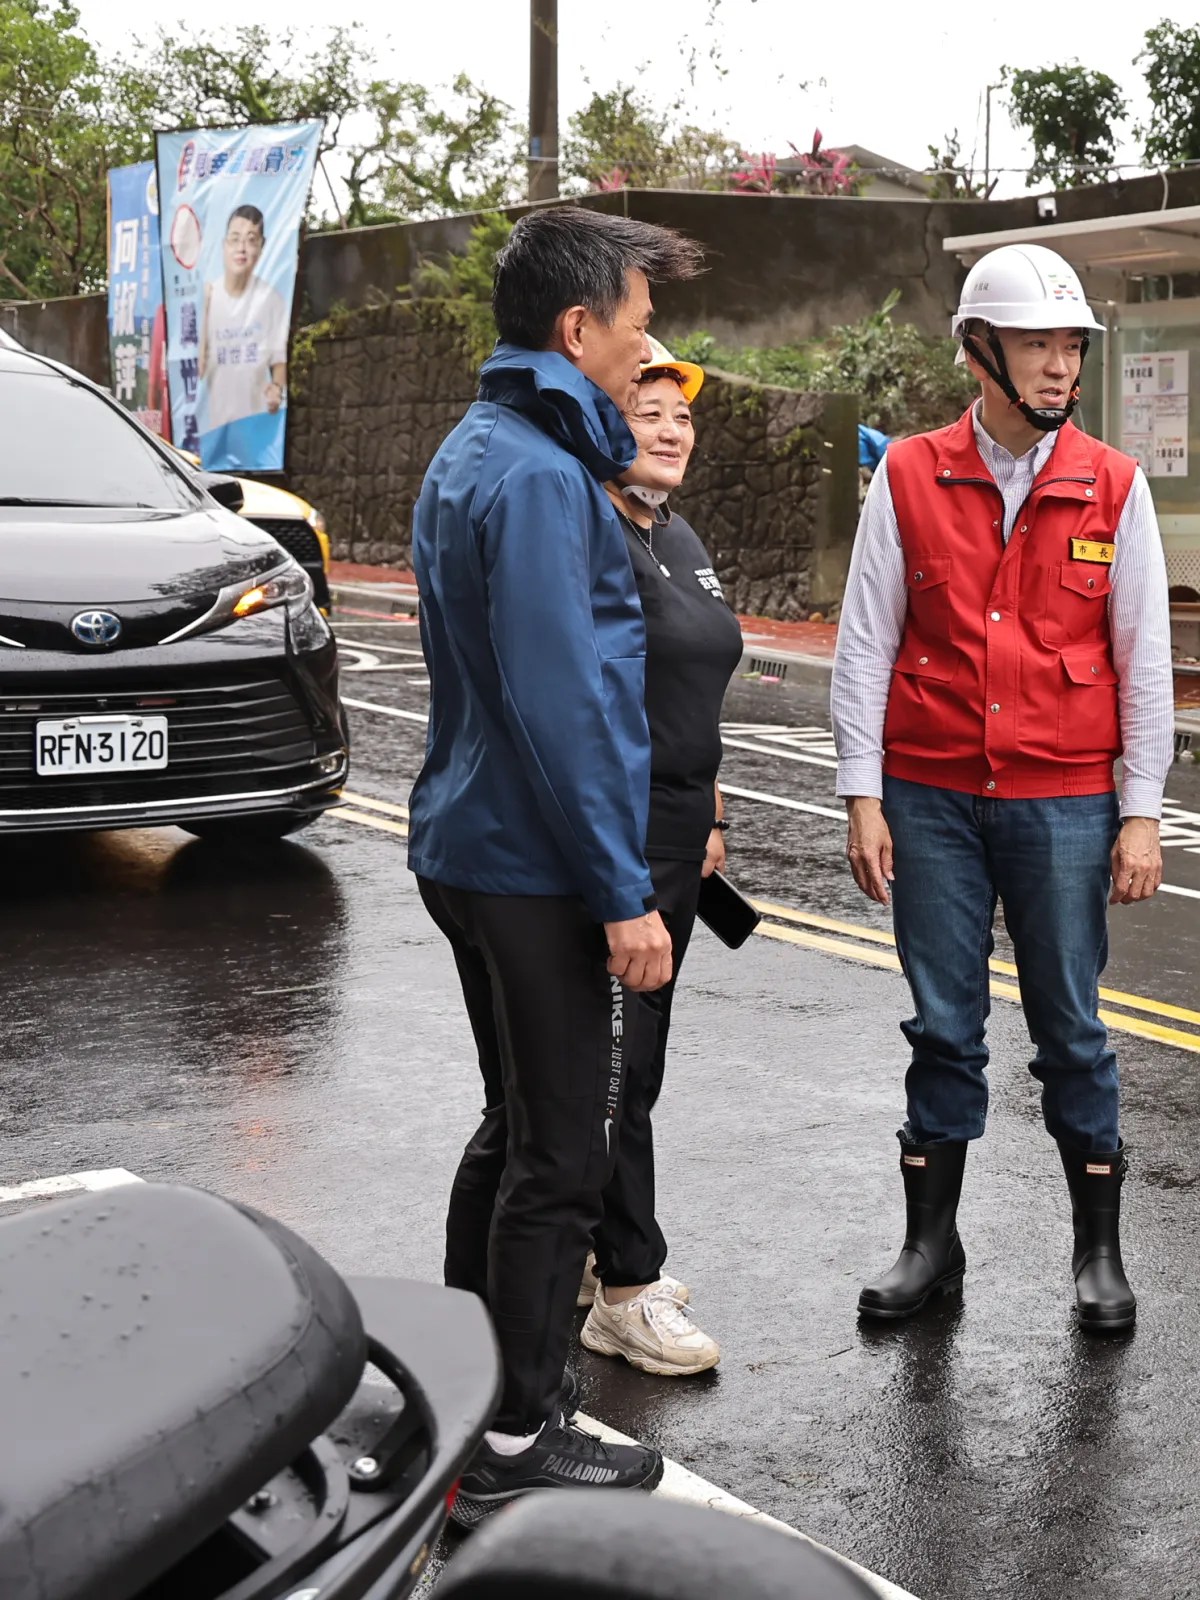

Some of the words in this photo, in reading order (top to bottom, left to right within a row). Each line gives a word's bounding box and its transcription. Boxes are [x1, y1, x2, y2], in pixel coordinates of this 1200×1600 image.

[1079, 545, 1108, 558] 市長
[610, 976, 623, 1037] NIKE
[611, 1044, 622, 1074] JUST
[608, 1077, 620, 1094] DO
[541, 1454, 618, 1483] PALLADIUM
